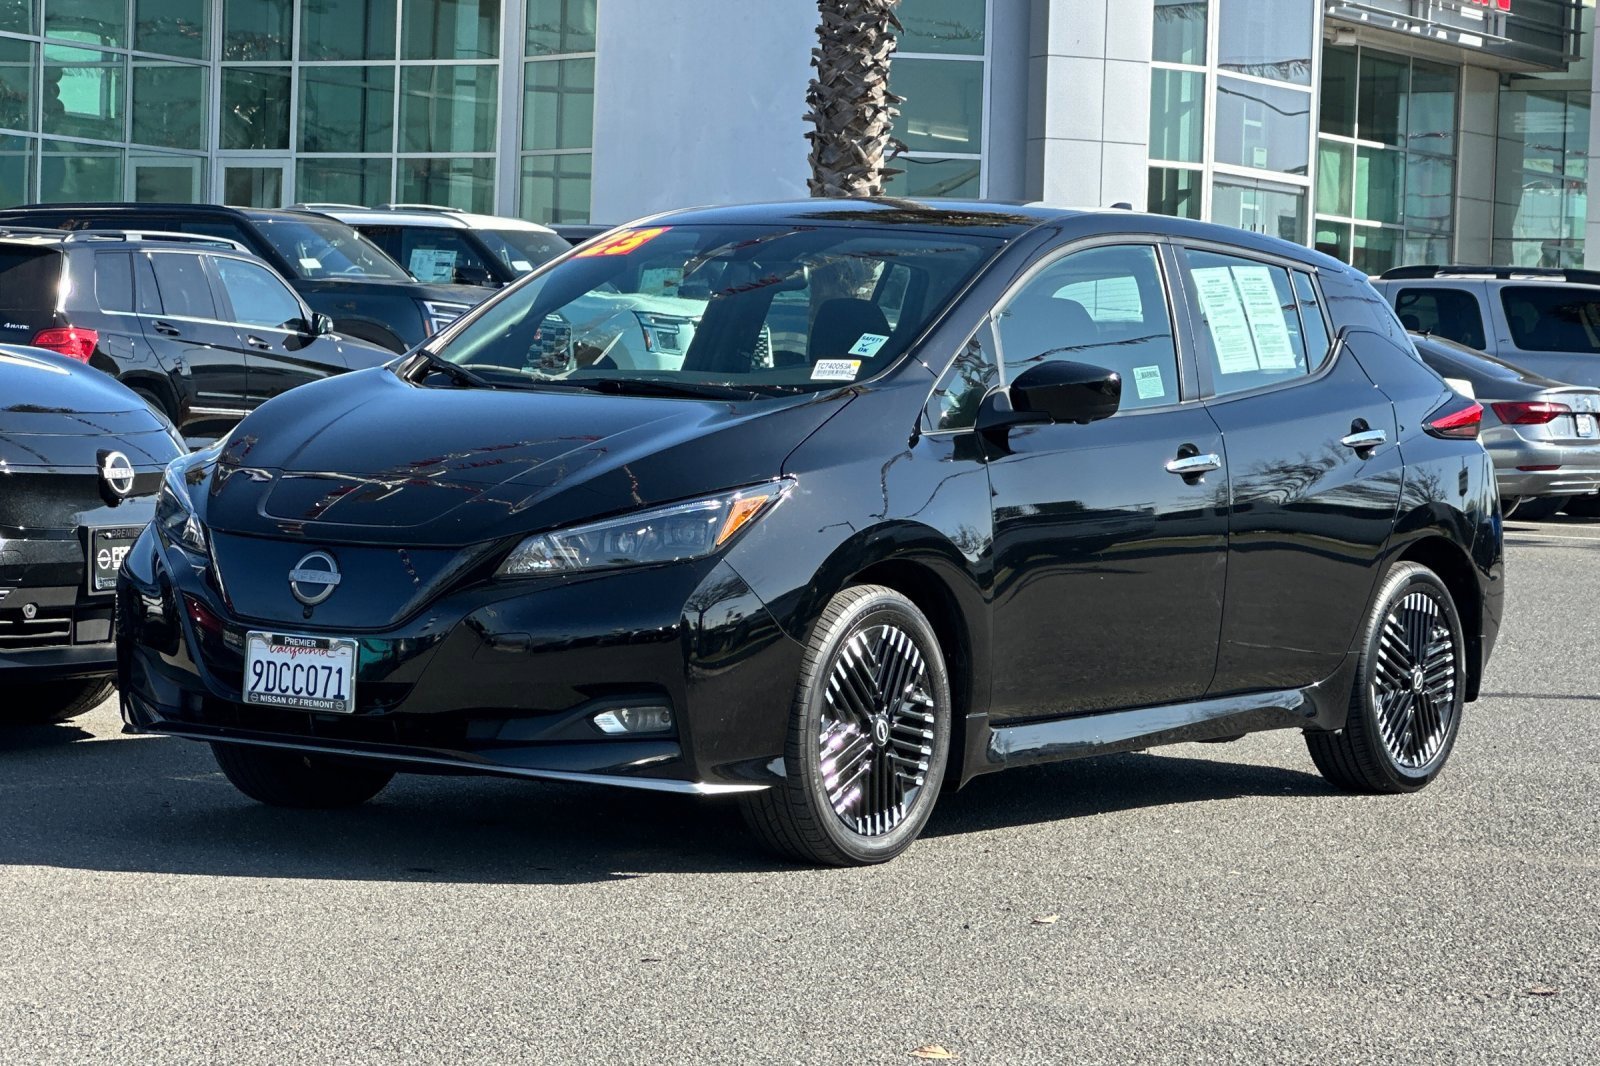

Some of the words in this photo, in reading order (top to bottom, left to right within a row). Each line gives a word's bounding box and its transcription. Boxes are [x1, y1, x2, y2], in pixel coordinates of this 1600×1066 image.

[284, 637, 317, 648] PREMIER
[250, 660, 345, 700] 9DCC071
[260, 694, 287, 704] NISSAN
[288, 698, 298, 706] OF
[299, 699, 335, 709] FREMONT
